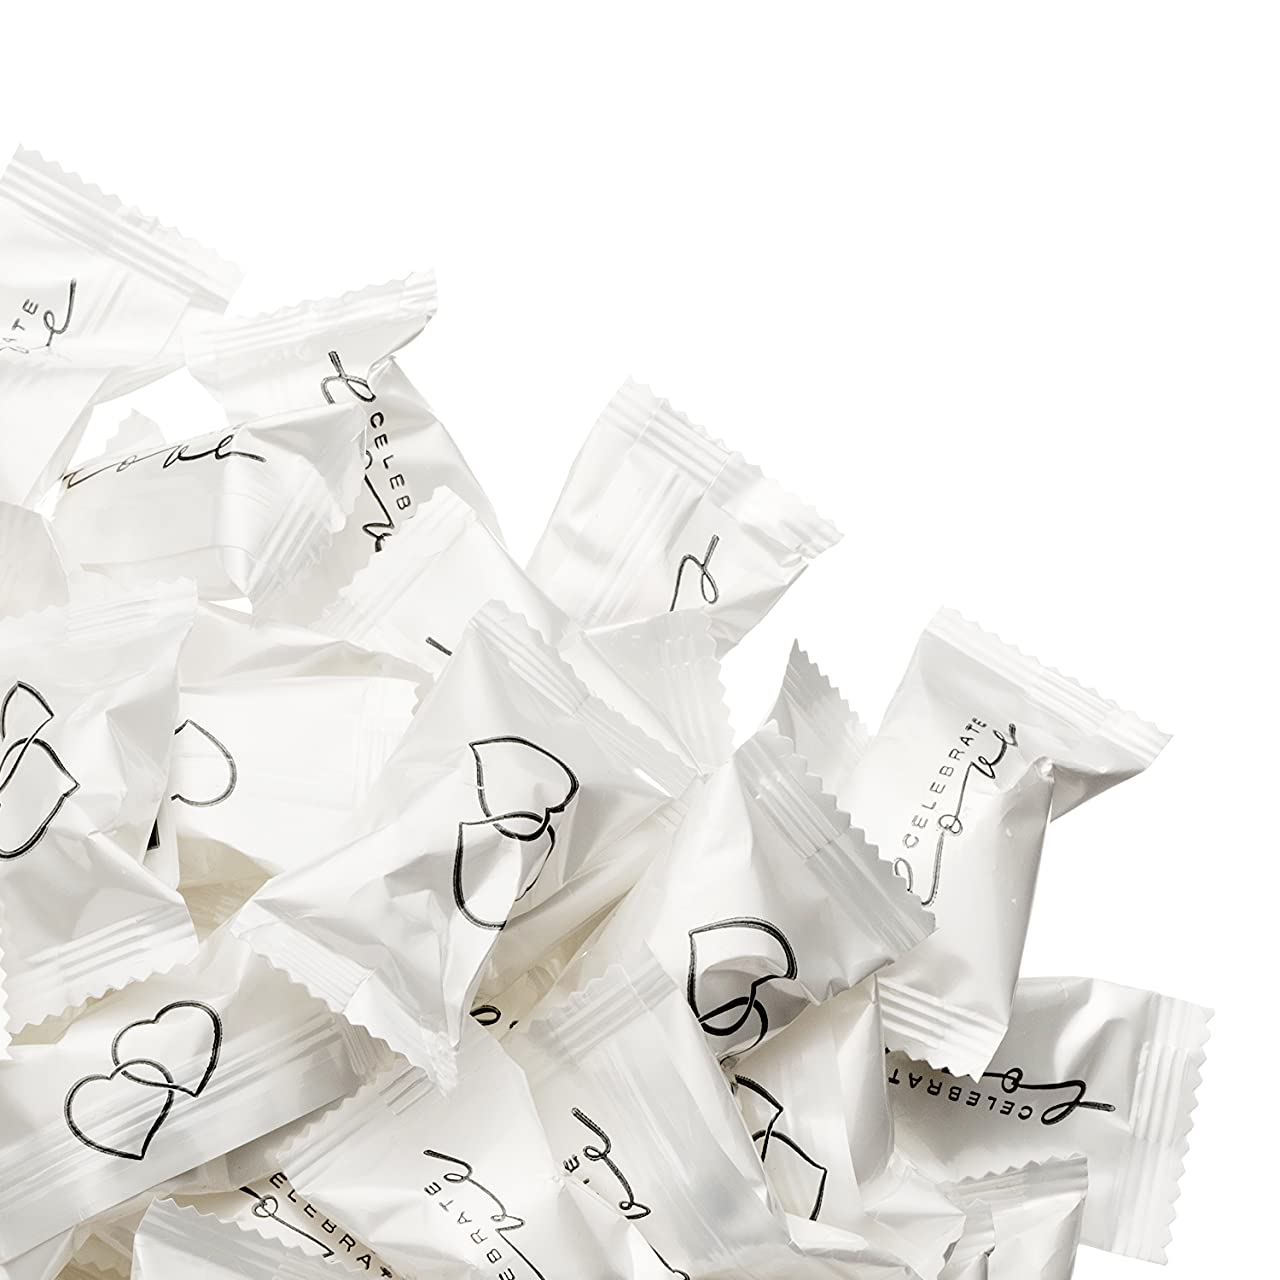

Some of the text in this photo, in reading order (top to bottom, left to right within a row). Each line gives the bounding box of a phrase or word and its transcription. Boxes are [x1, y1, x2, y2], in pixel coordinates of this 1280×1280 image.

[370, 411, 414, 512] CELEB
[903, 717, 988, 849] CELEBRATE
[888, 1068, 1034, 1121] CELEBRAT
